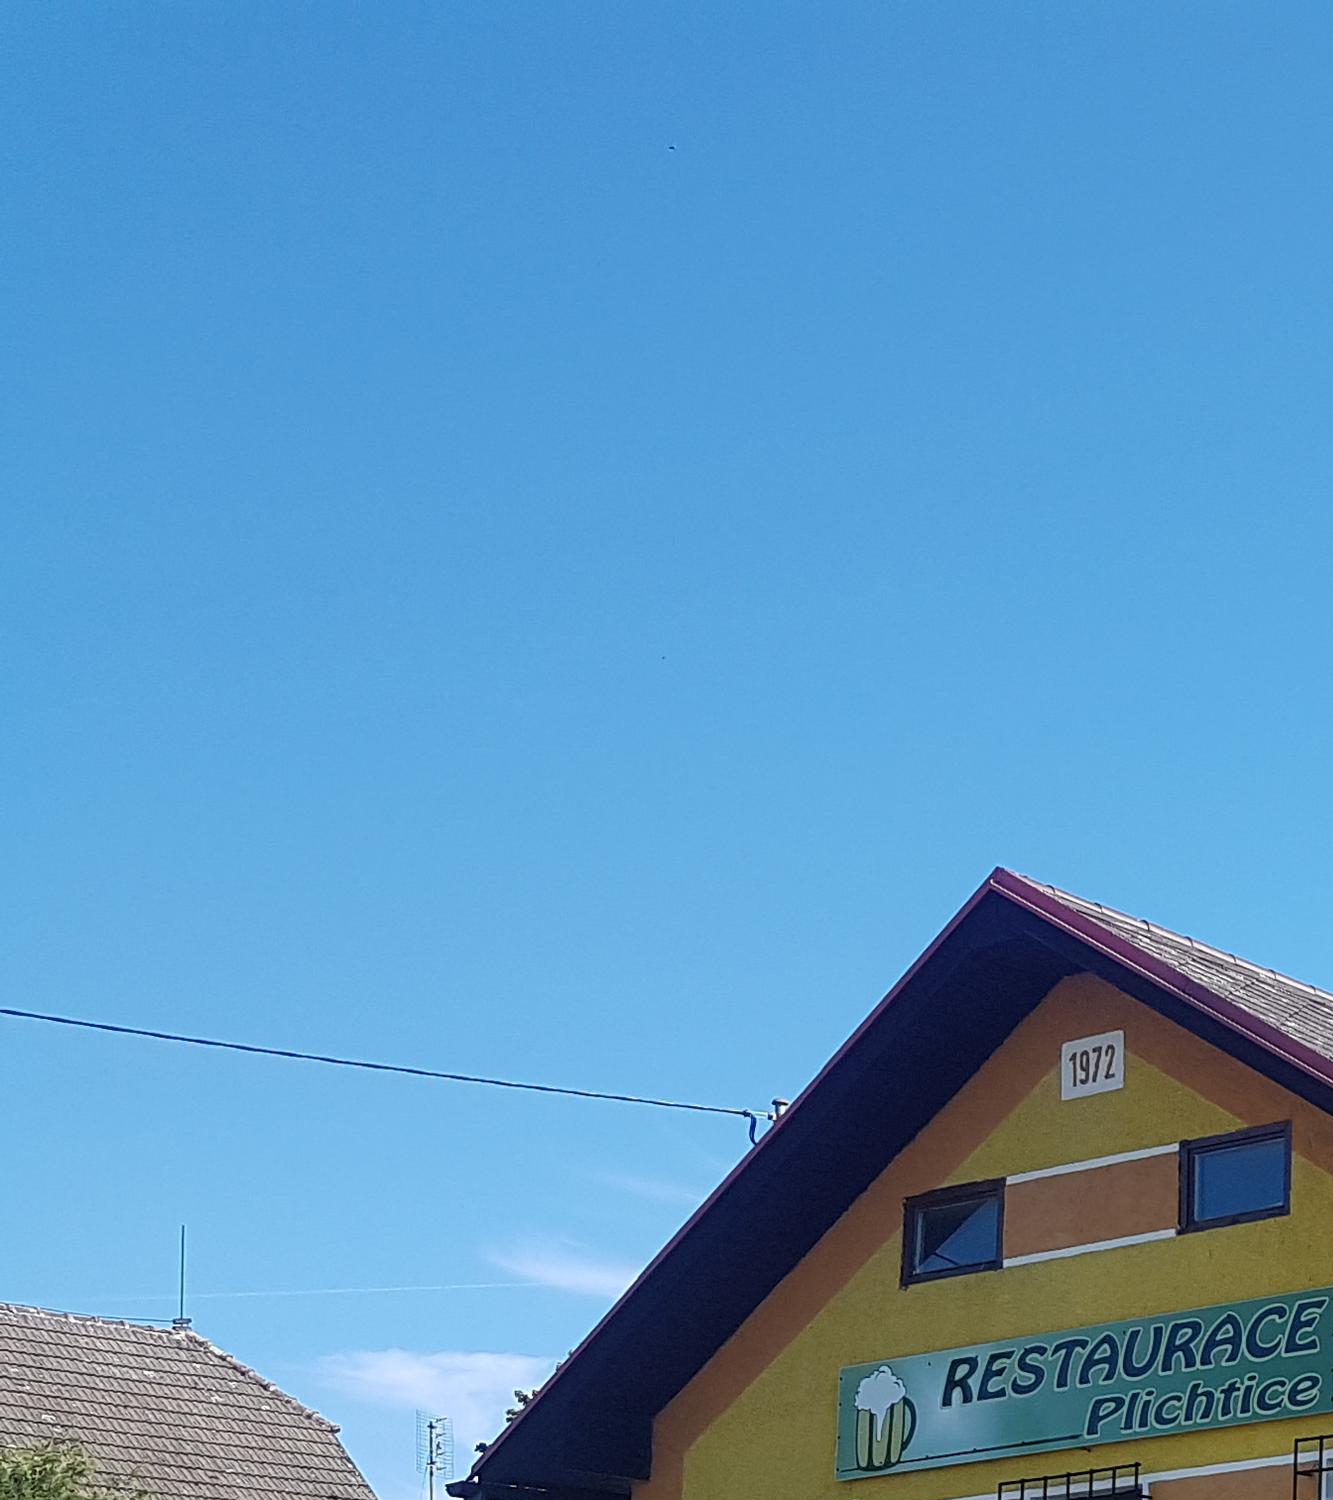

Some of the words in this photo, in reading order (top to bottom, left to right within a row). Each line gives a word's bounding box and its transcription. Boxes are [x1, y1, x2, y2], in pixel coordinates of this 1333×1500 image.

[1069, 1044, 1116, 1088] 1972
[940, 1297, 1329, 1409] RESTAURACE
[1084, 1373, 1322, 1438] Plichtice
